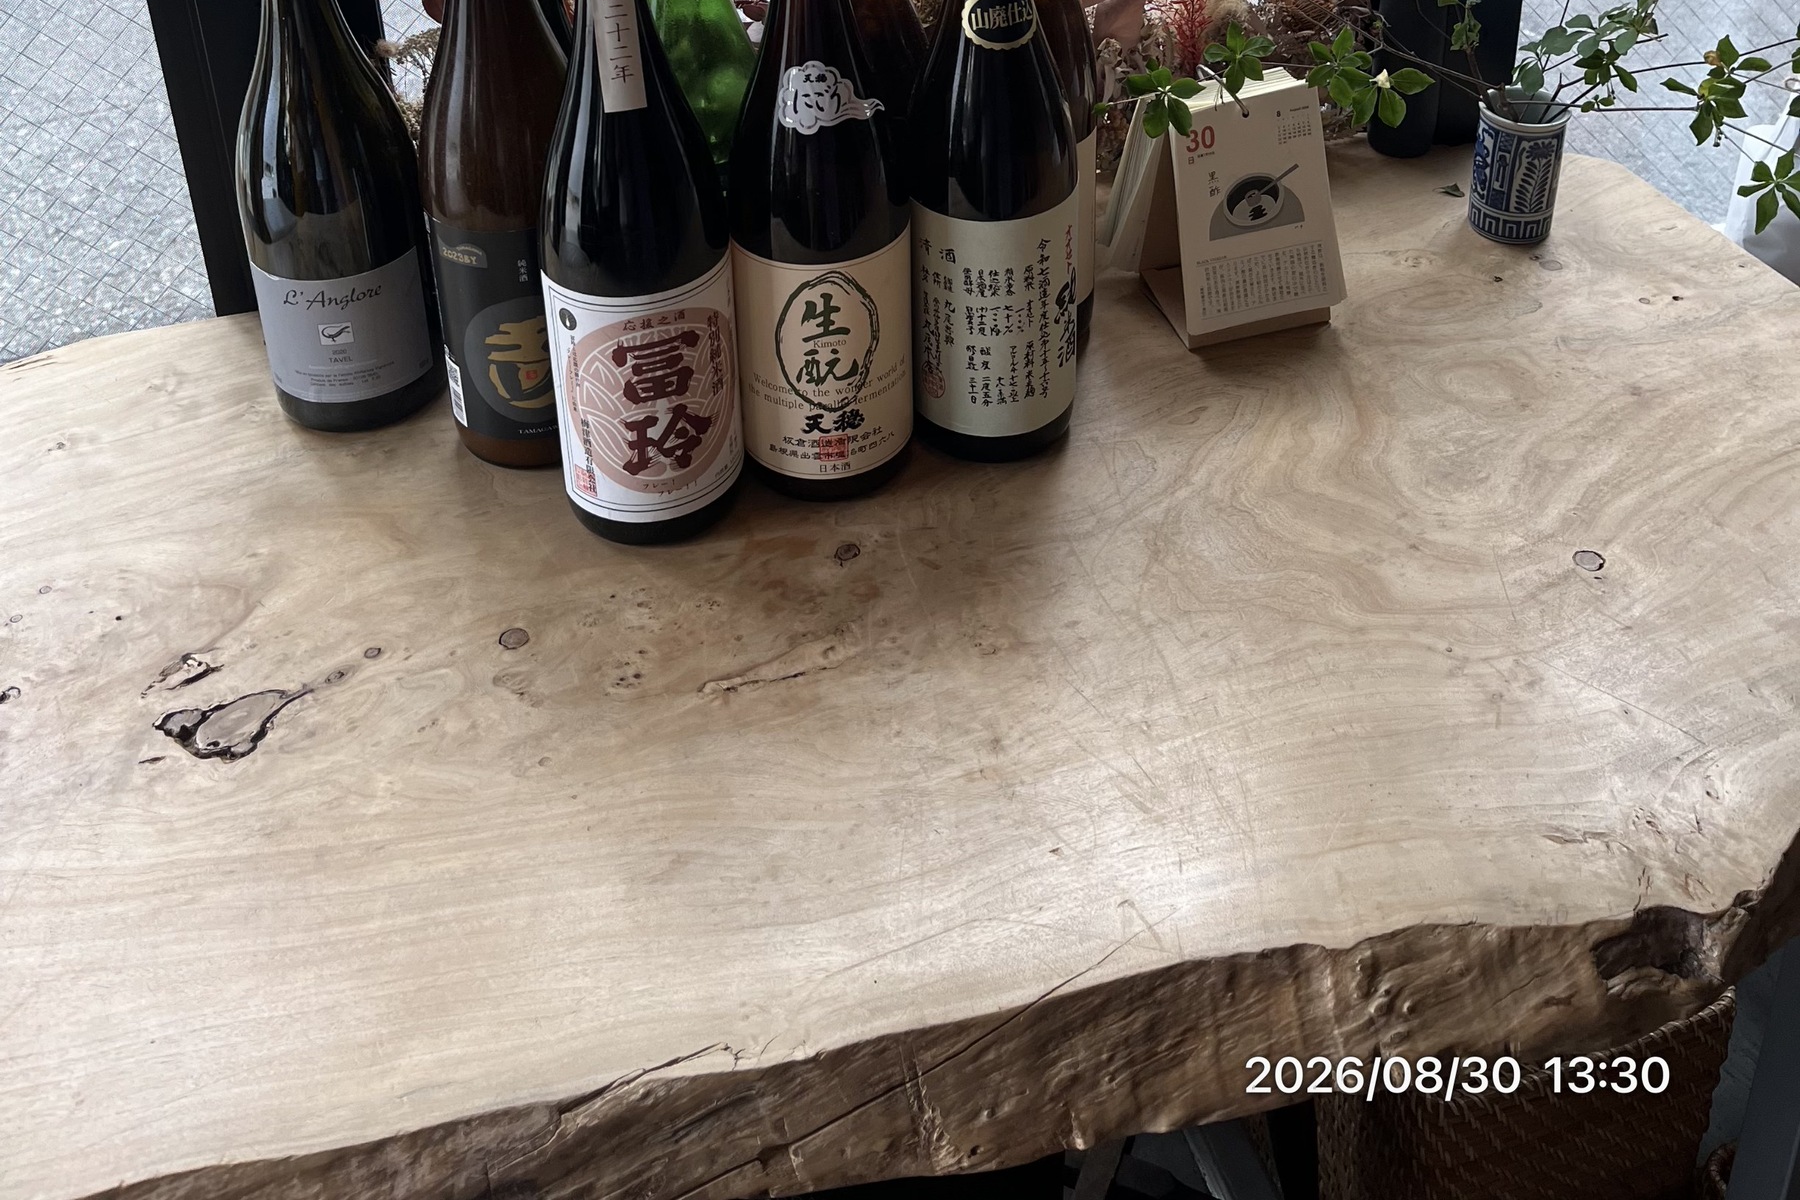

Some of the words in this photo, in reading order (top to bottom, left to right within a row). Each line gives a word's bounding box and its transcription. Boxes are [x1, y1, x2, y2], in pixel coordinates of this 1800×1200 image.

[792, 84, 842, 115] にごり
[1186, 125, 1216, 153] 30
[1187, 156, 1195, 165] 日
[1208, 171, 1221, 197] 黒酢
[517, 259, 528, 282] 純米酒
[622, 308, 686, 331] 応援之酒
[706, 311, 724, 397] 特別純米酒
[813, 339, 847, 349] Kimoto
[328, 356, 353, 364] TAVEL
[753, 371, 794, 395] Welcome
[813, 387, 830, 397] the
[876, 362, 898, 383] world
[764, 393, 804, 410] multiple
[820, 461, 851, 473] 日本酒
